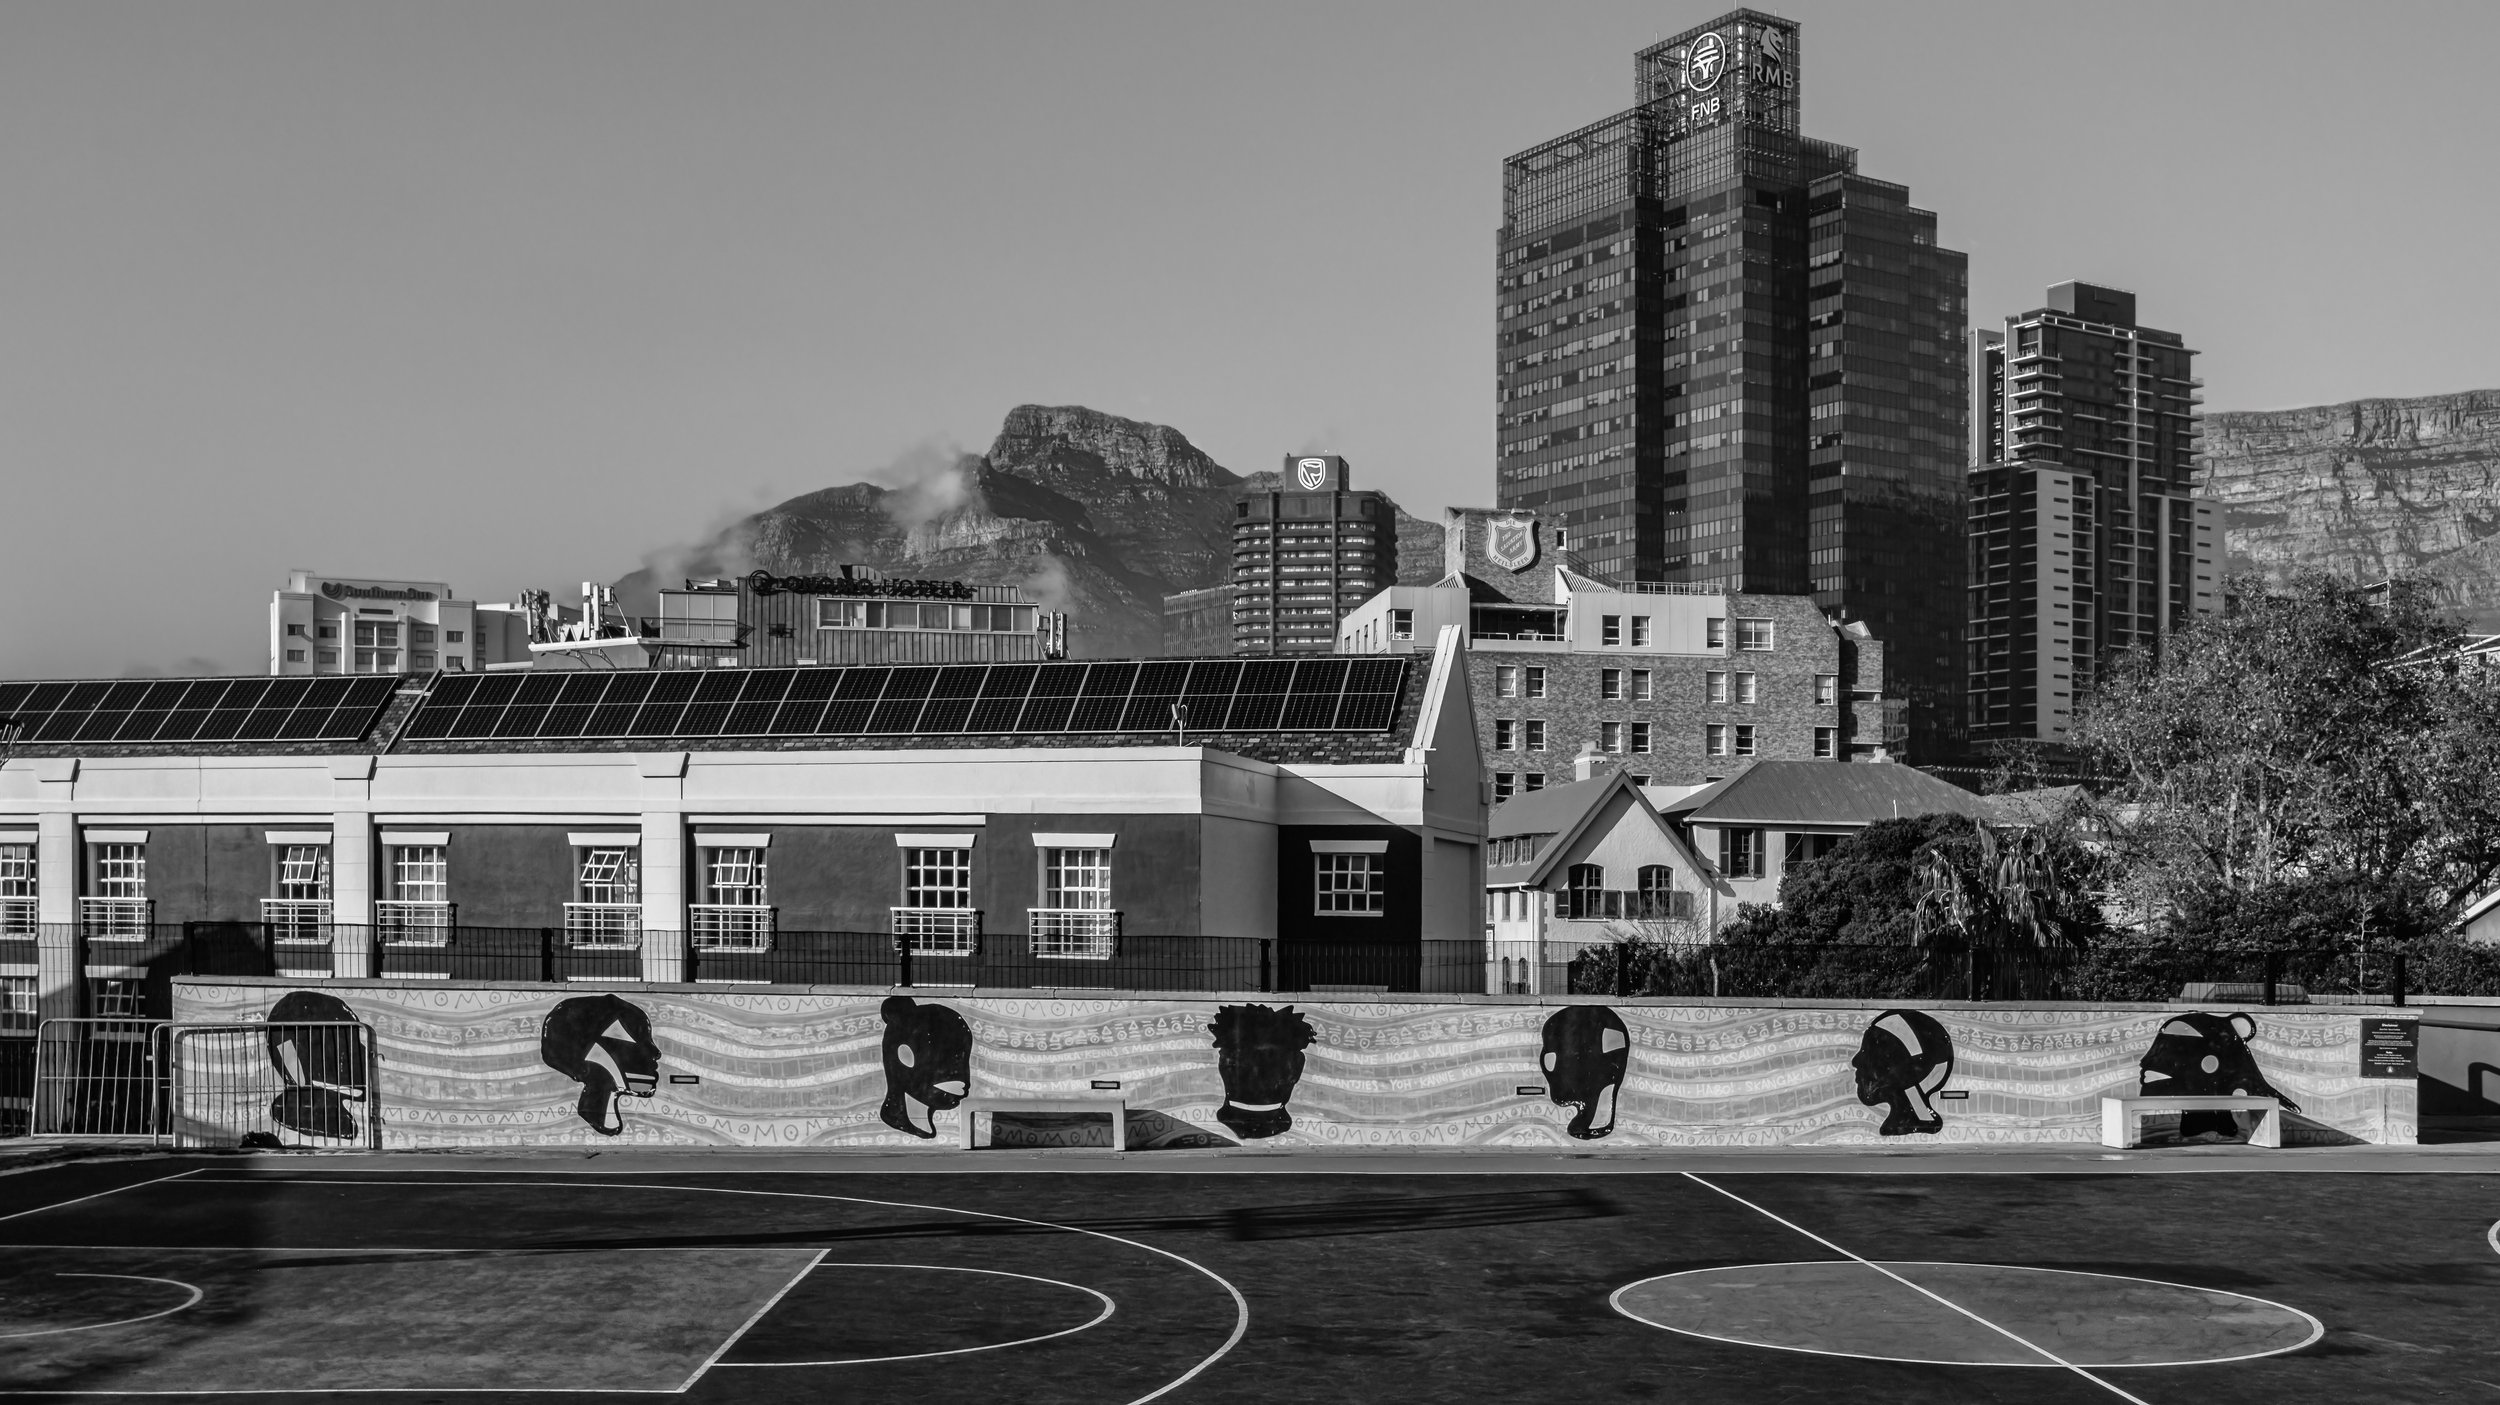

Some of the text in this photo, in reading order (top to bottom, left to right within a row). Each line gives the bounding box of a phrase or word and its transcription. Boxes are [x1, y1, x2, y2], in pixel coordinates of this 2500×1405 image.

[1752, 63, 1794, 88] RMB
[1692, 97, 1720, 120] FNB
[1427, 1043, 1467, 1058] SALUTE
[1712, 1043, 1777, 1066] OKSALAYO
[1783, 1034, 1829, 1049] TWALA
[2016, 1083, 2074, 1097] DUIDELIK
